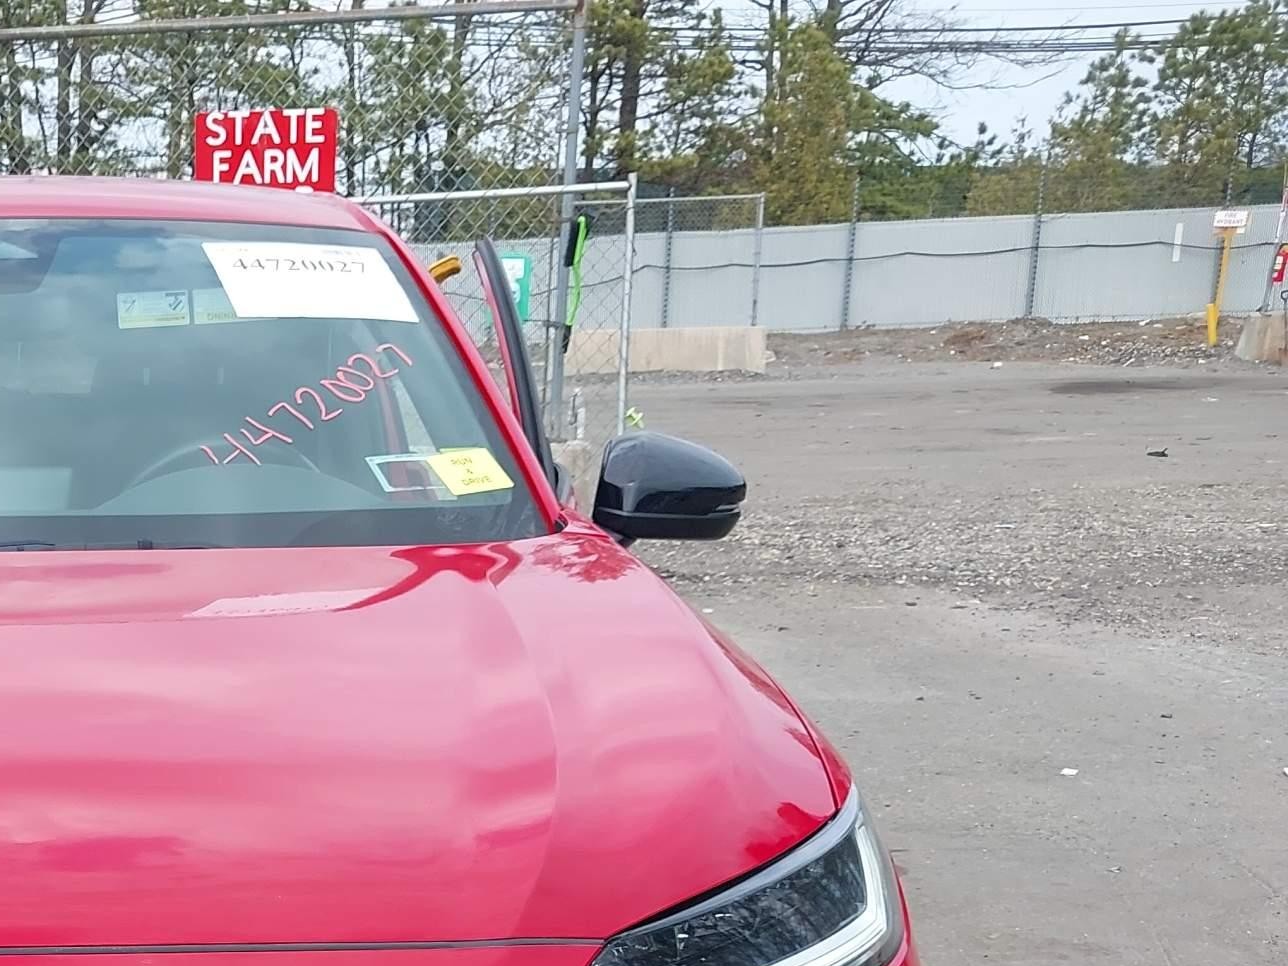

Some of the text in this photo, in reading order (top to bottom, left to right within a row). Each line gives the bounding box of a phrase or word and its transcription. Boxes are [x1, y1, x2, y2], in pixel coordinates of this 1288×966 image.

[205, 107, 325, 146] STATE
[212, 147, 319, 185] FARM
[199, 343, 412, 466] 44720027
